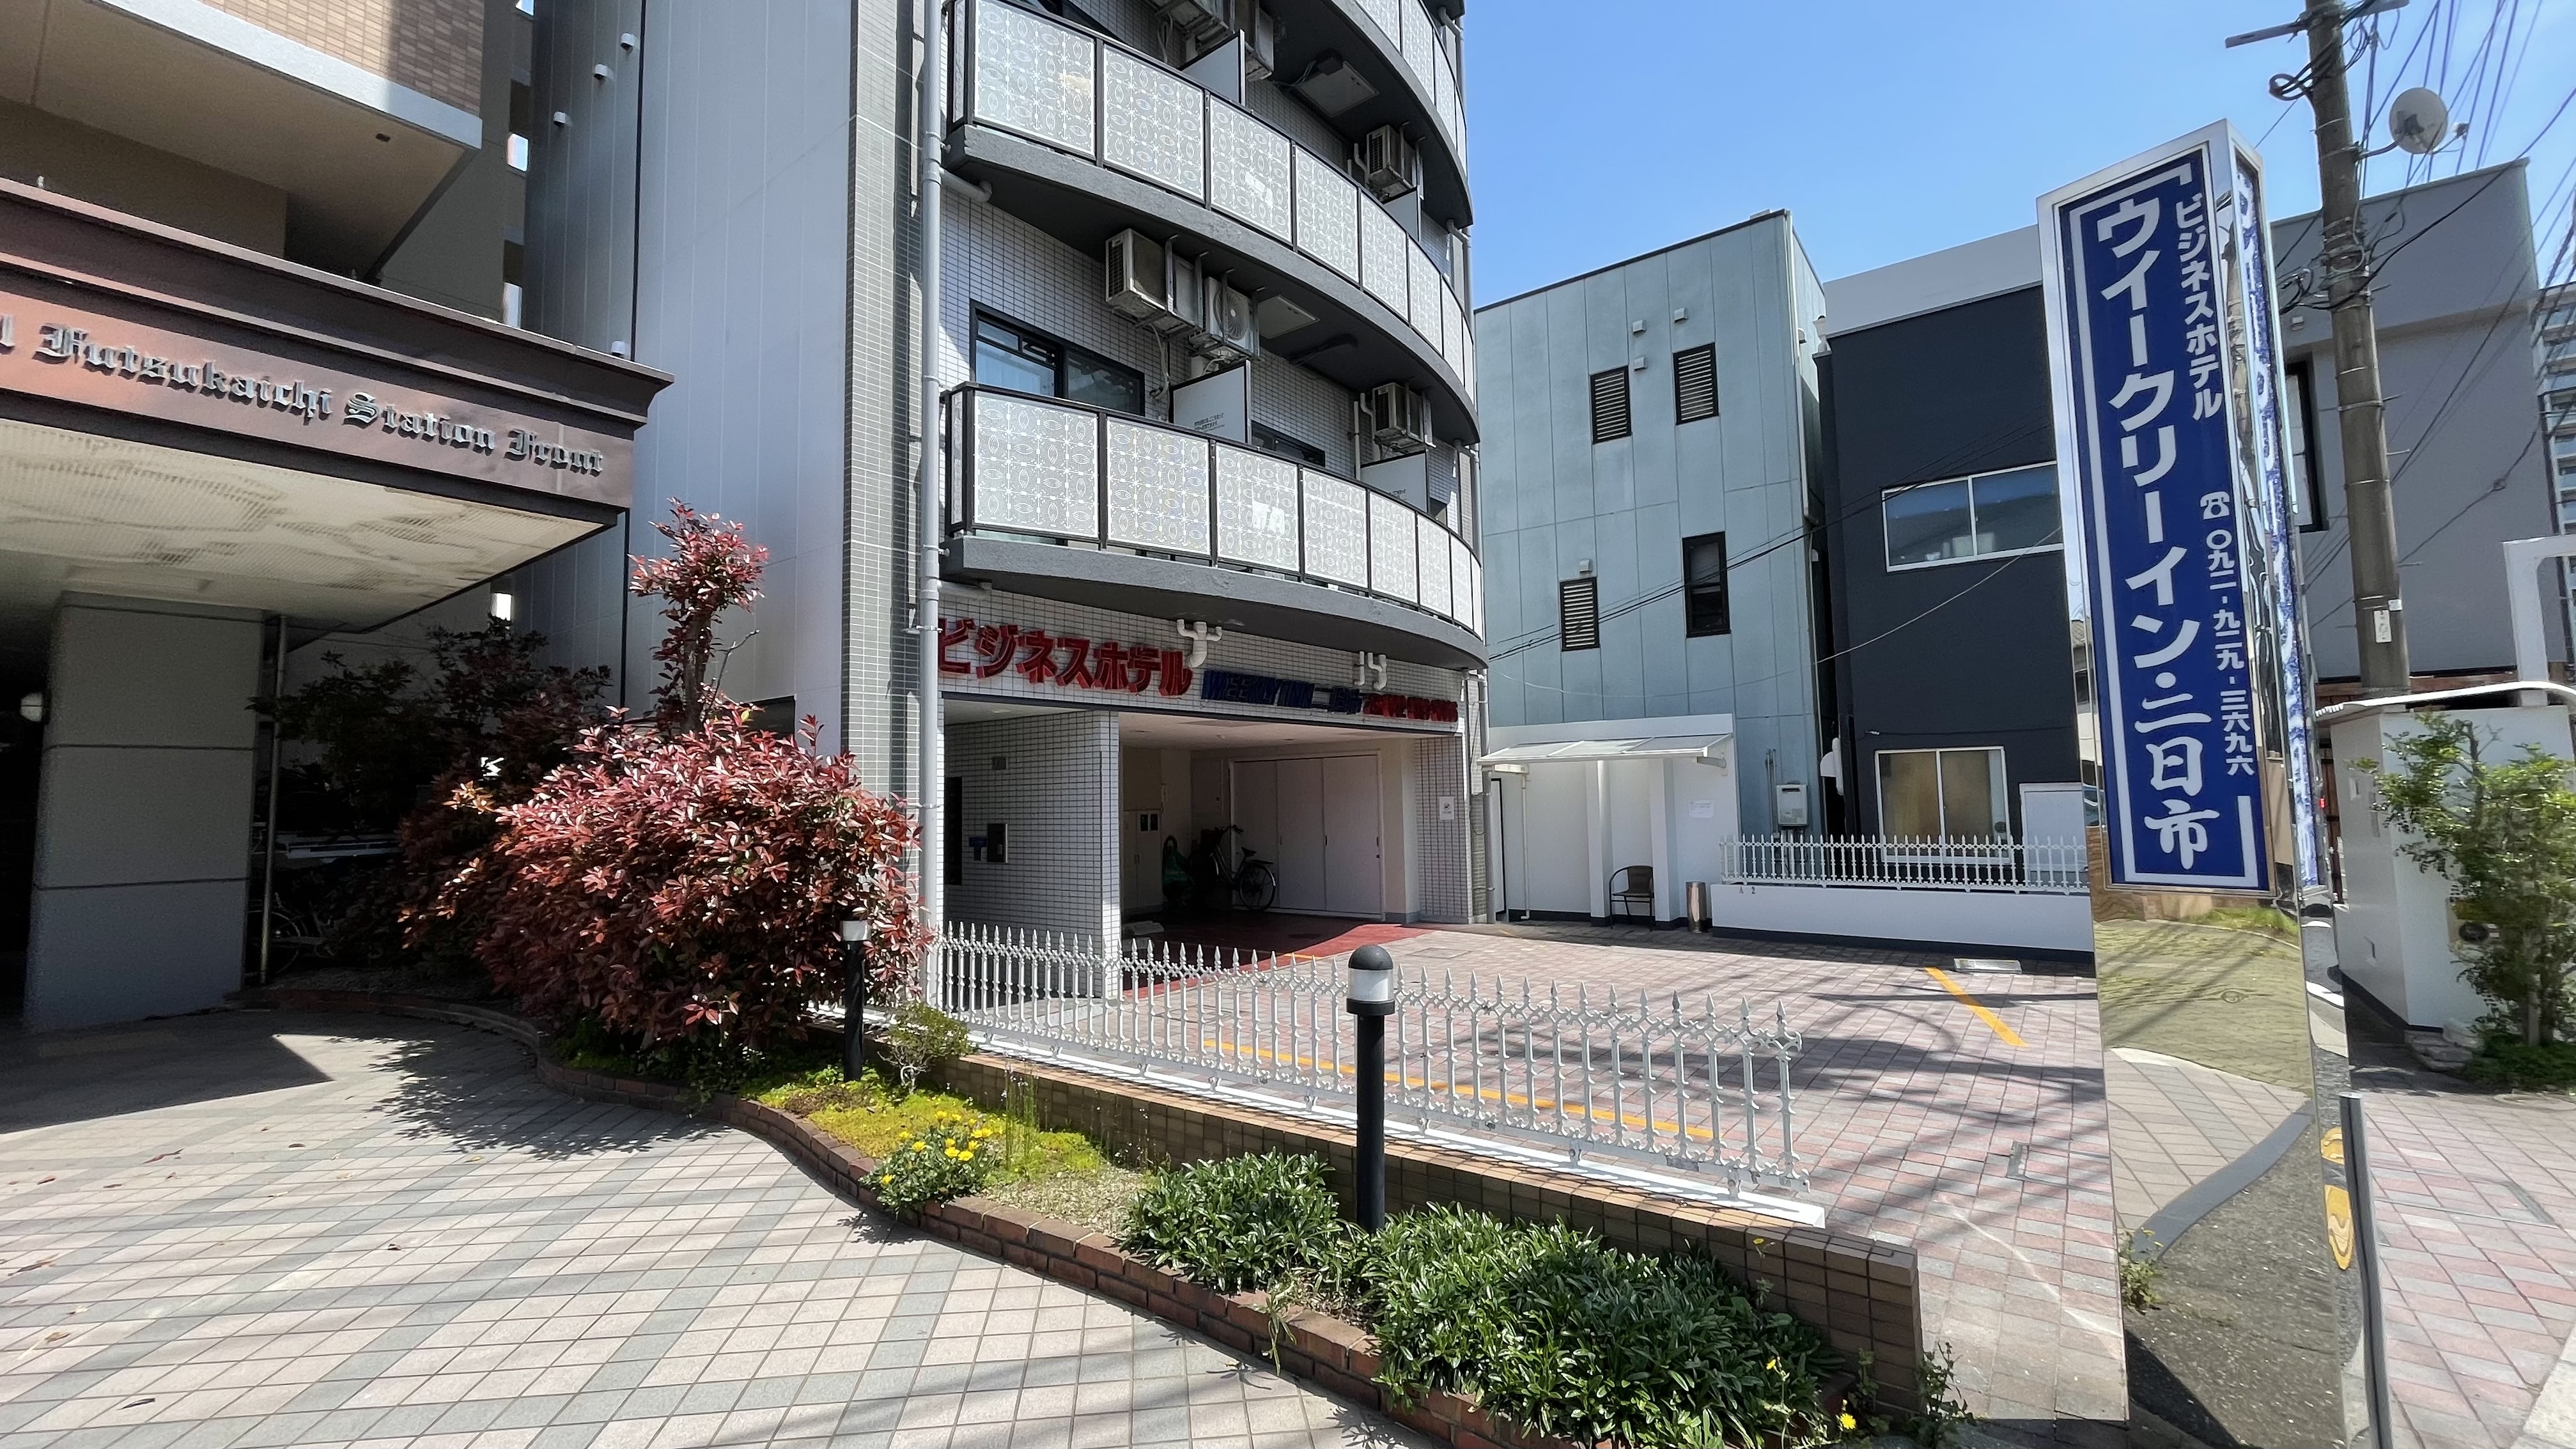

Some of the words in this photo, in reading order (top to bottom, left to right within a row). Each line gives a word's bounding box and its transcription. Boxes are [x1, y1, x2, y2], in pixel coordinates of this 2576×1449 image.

[2176, 192, 2223, 421] ビジネスホテル
[35, 322, 332, 419] Futsukaichi
[345, 391, 495, 449] Station
[506, 430, 604, 473] Front
[938, 617, 1193, 697] ビジネスホテル
